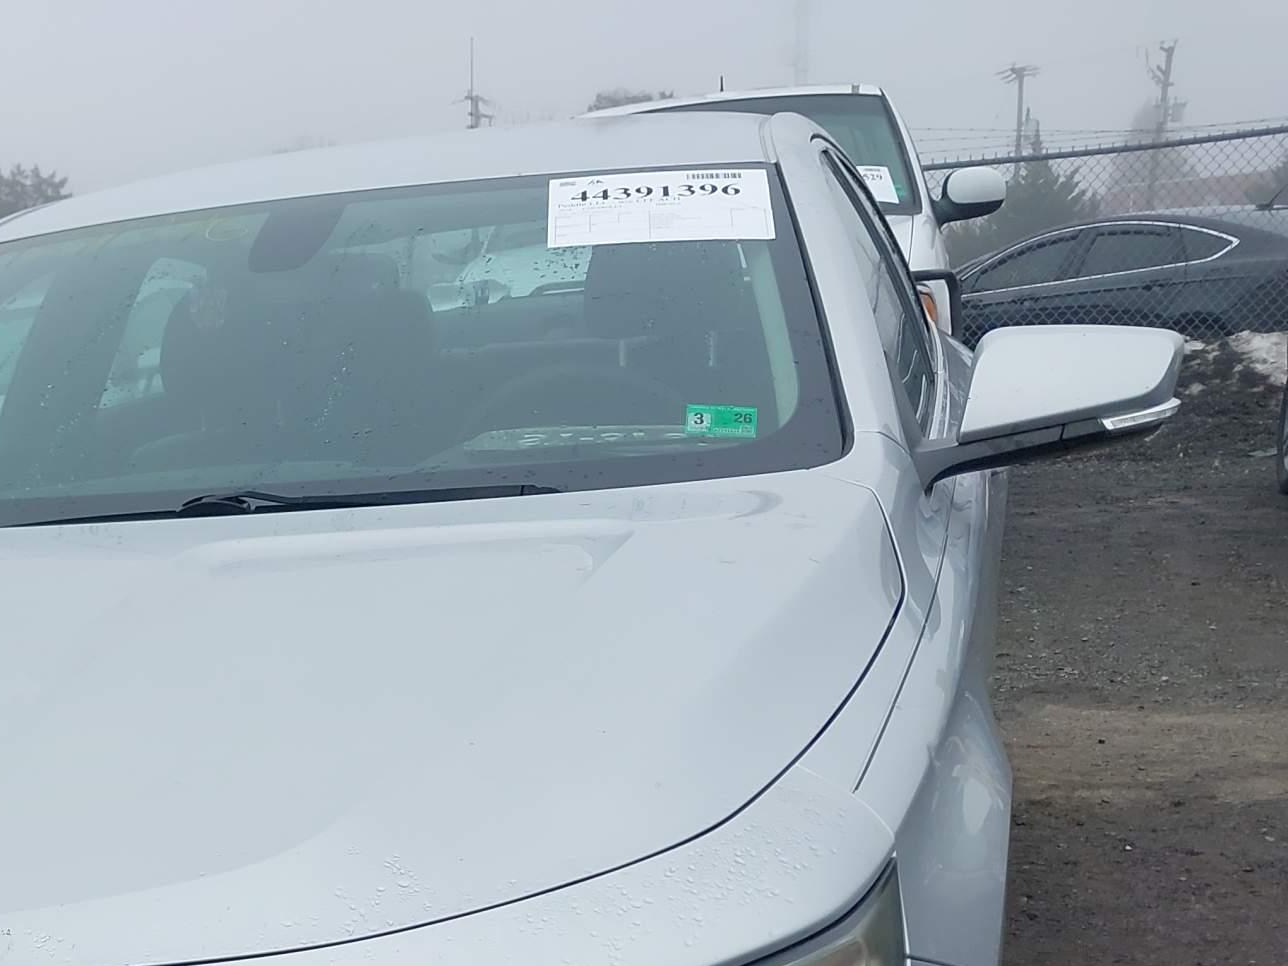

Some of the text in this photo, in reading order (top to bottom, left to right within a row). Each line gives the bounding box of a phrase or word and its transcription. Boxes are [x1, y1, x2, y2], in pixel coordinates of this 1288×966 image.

[570, 183, 741, 202] 44391396
[693, 412, 753, 425] 3 26
